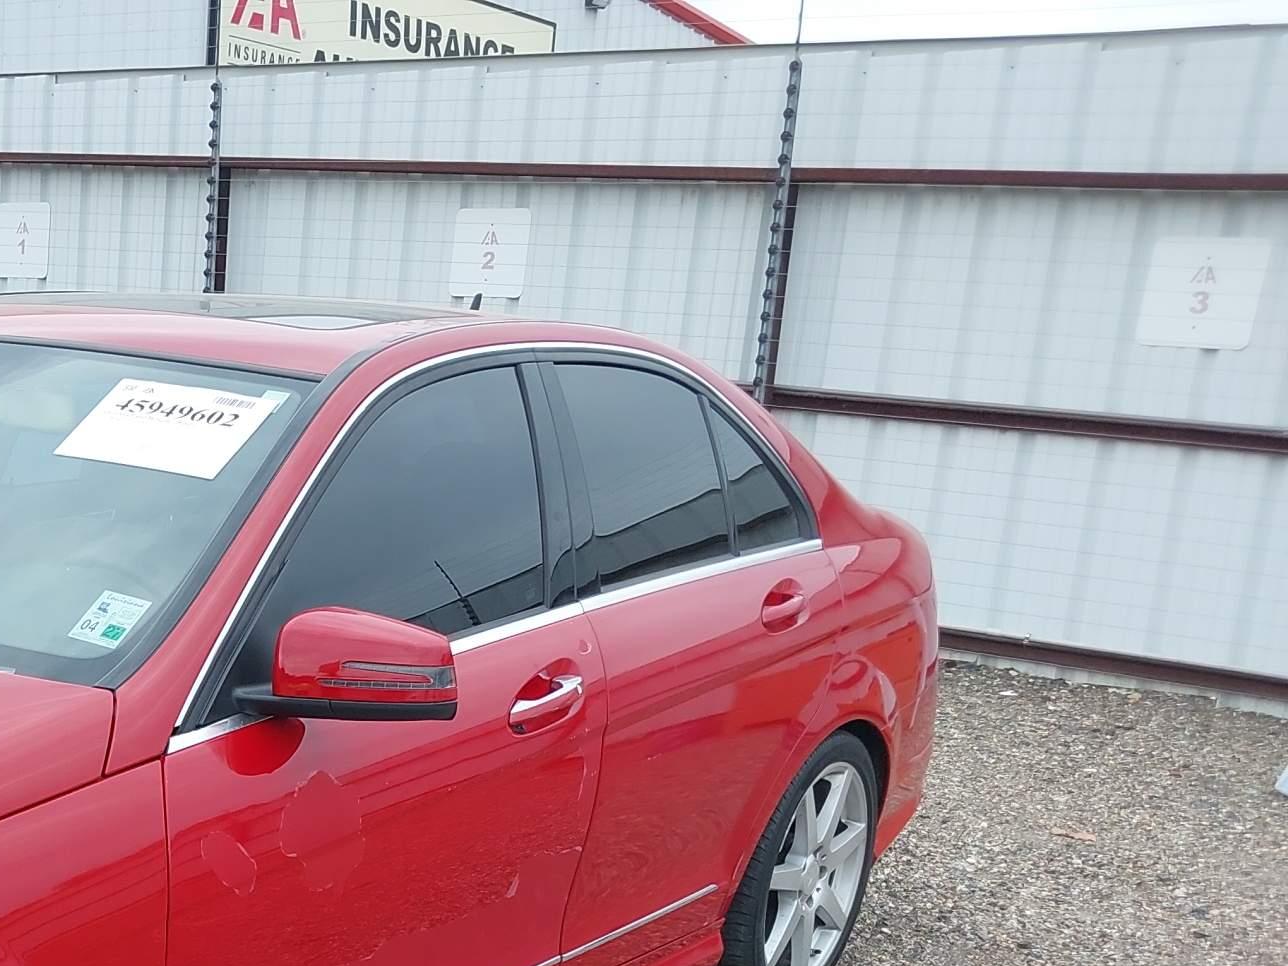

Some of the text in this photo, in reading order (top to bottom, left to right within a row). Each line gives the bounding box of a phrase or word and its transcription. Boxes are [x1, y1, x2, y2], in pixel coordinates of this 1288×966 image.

[349, 0, 515, 57] INSURAN
[228, 42, 301, 64] INSURAN
[17, 238, 25, 255] 1
[480, 251, 496, 270] 2
[1189, 291, 1210, 314] 3
[115, 398, 240, 427] 45949602
[80, 619, 100, 632] 04
